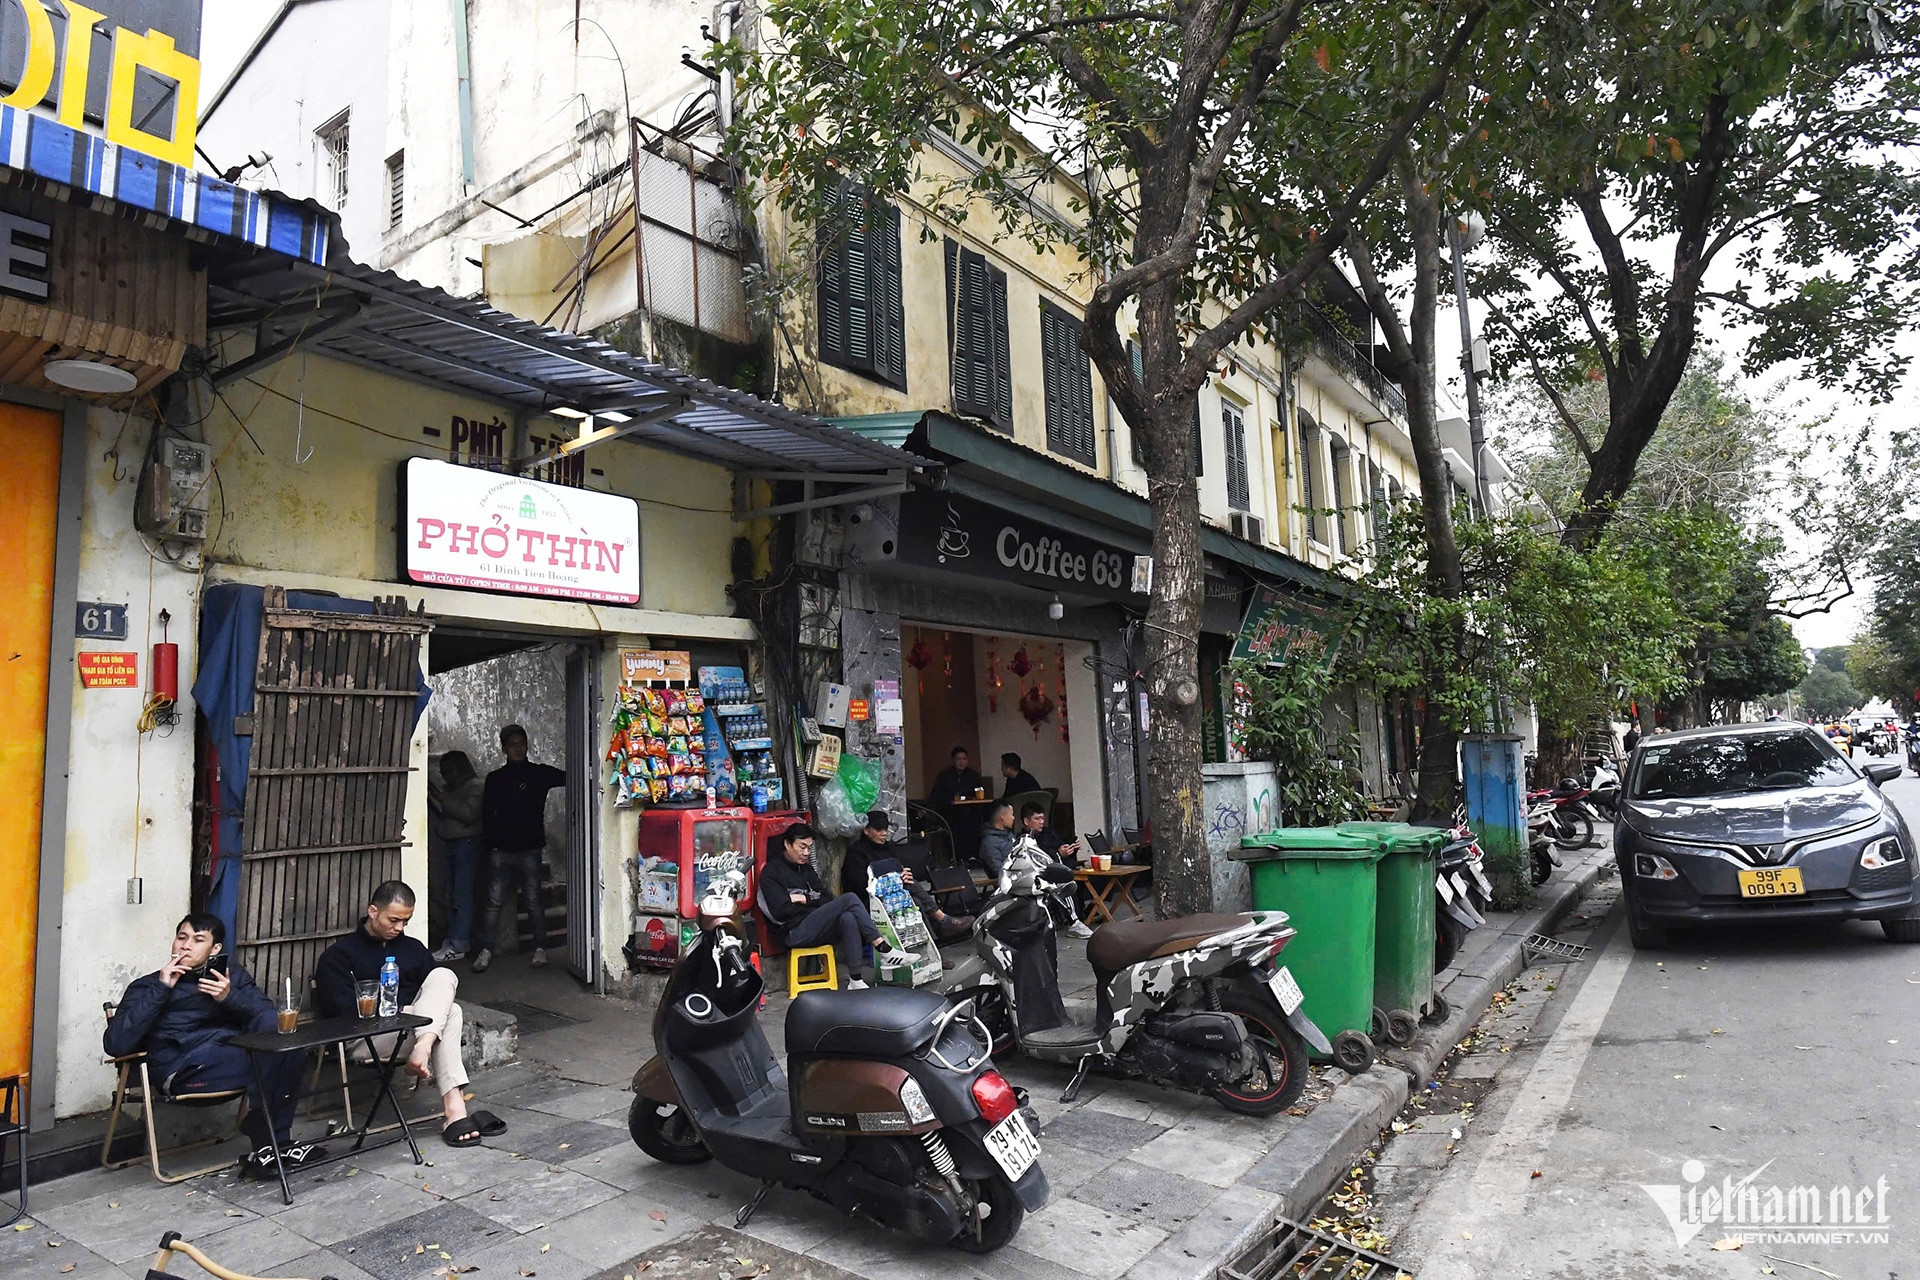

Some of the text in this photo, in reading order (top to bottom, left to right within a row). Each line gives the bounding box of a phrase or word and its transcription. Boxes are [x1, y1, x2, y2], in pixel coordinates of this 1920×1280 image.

[416, 513, 625, 574] PHỞ THÌN
[996, 526, 1123, 589] Coffee 63
[480, 562, 491, 573] 61
[470, 578, 491, 588] OPEN
[492, 581, 511, 590] TIME
[528, 585, 540, 593] AM
[560, 589, 572, 597] PM
[83, 608, 114, 633] 61
[1755, 870, 1782, 883] 99F
[1747, 882, 1798, 896] 009.13
